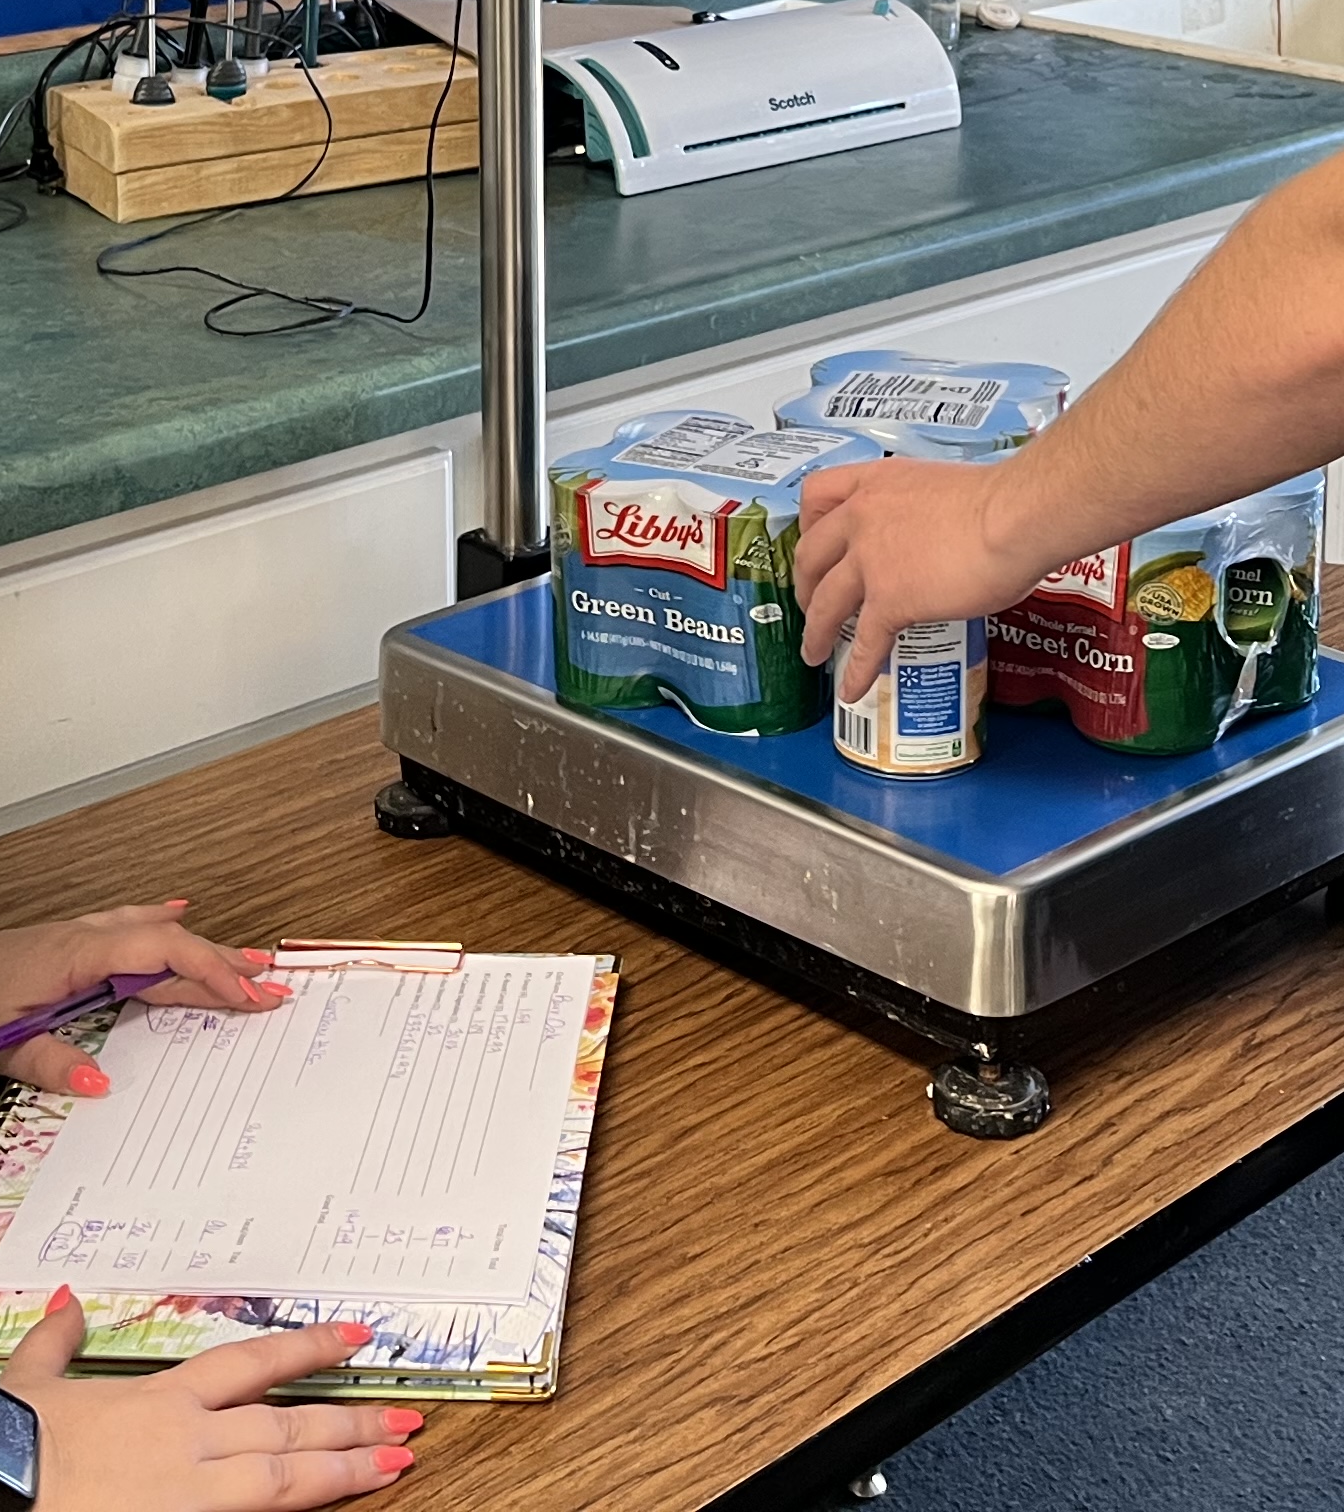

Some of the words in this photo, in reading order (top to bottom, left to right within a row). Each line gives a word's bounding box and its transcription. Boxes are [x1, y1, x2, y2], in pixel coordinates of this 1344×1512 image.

[768, 91, 817, 112] Scotch
[596, 501, 706, 550] Libby's
[1231, 568, 1261, 582] nel
[648, 587, 671, 601] Cut
[1151, 591, 1173, 606] USA
[1228, 586, 1274, 606] orn
[1139, 595, 1180, 617] GROWN
[571, 590, 656, 625] Green
[663, 607, 746, 645] Beans
[1027, 610, 1065, 633] Whole
[1066, 622, 1097, 638] Kernel
[985, 614, 1069, 659] Sweet
[1074, 638, 1134, 673] Corn
